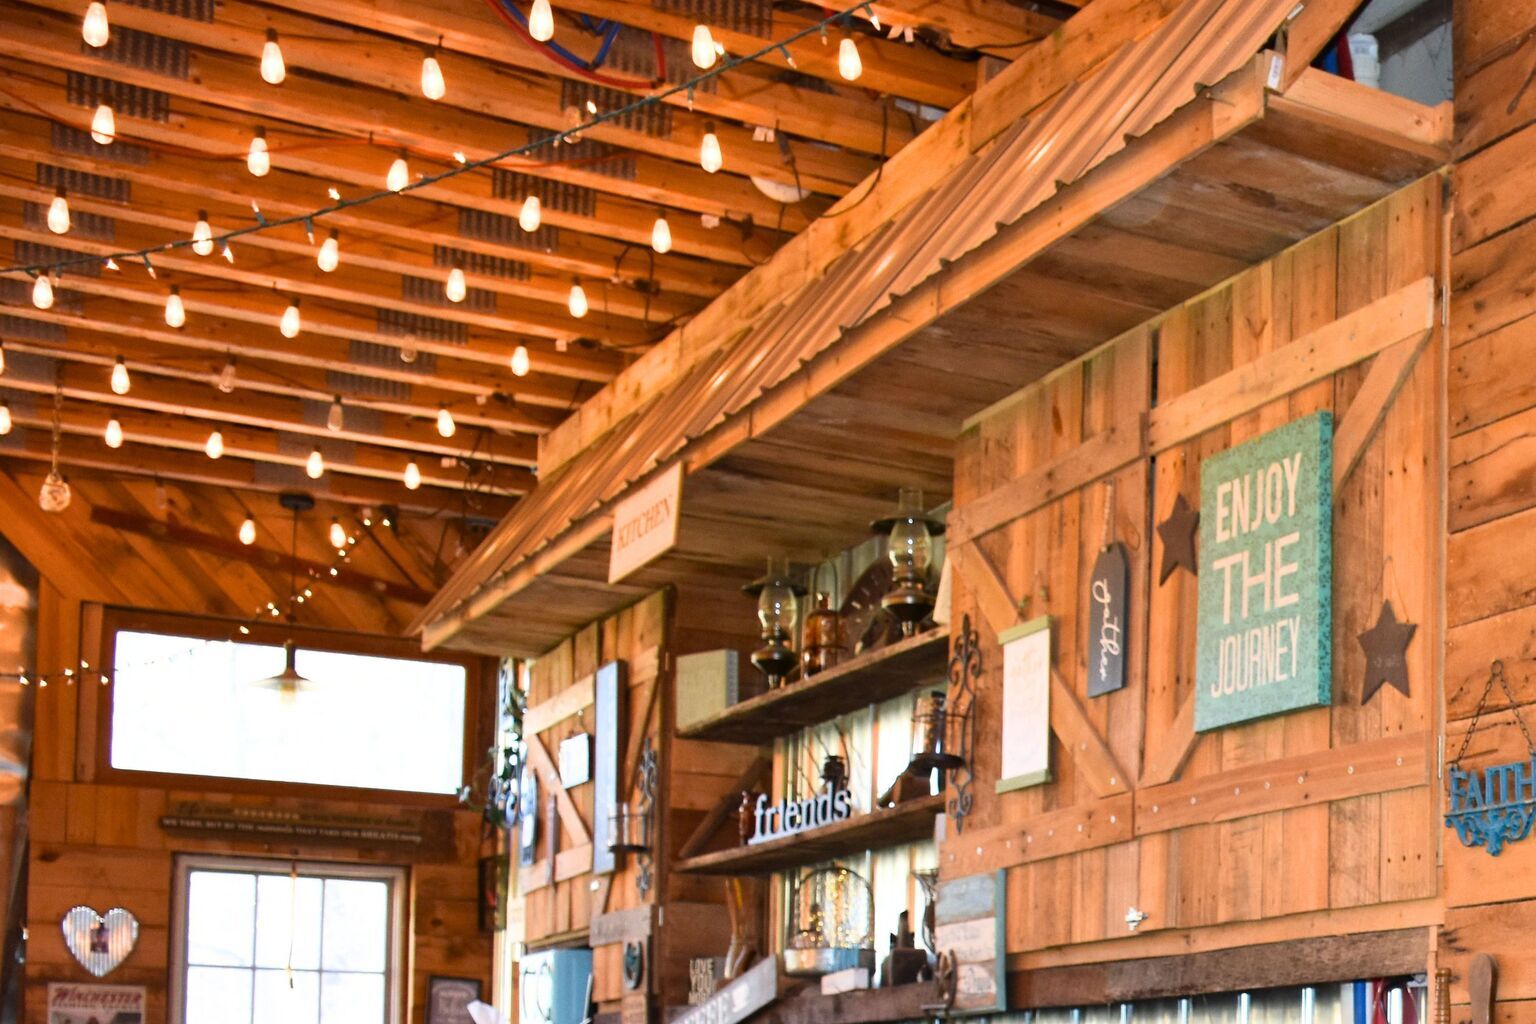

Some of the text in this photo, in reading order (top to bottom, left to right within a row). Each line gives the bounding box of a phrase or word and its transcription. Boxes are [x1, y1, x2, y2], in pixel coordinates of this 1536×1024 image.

[617, 495, 672, 553] KITCHEN
[1216, 452, 1302, 543] ENJOY
[1213, 531, 1300, 625] THE
[1092, 578, 1120, 682] gather
[1211, 616, 1300, 698] JOURNEY
[752, 781, 851, 842] friends
[689, 958, 713, 976] LOVE
[690, 974, 713, 993] YOU
